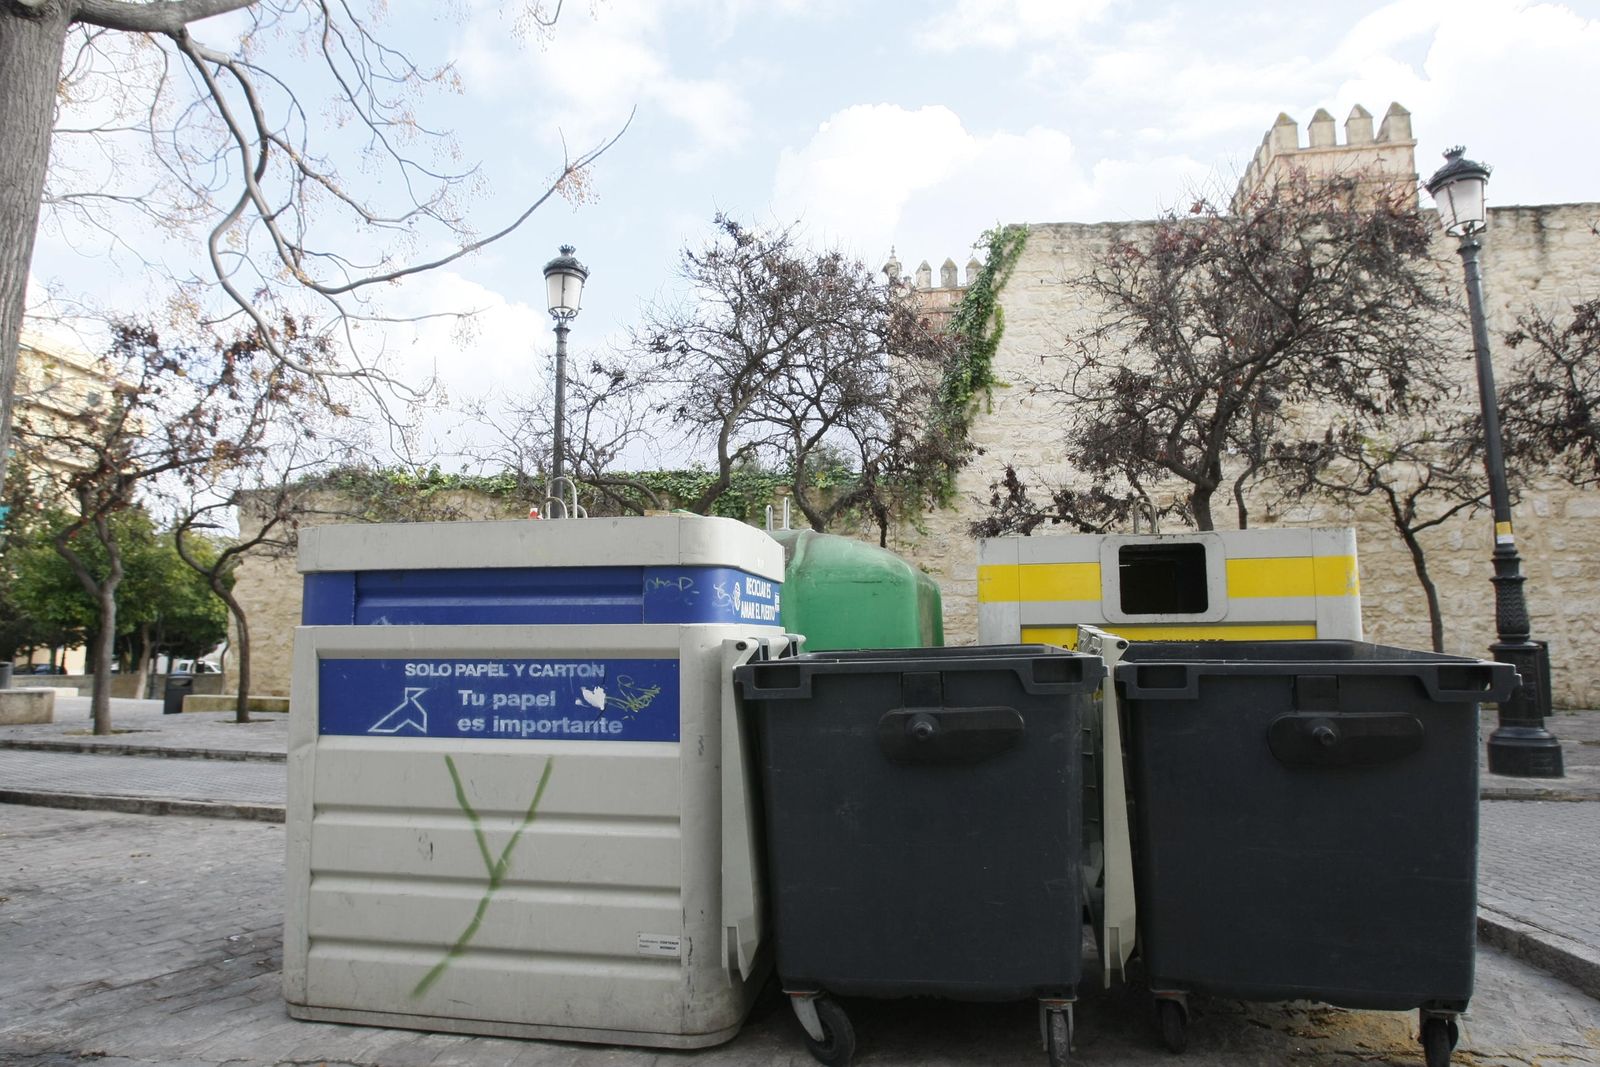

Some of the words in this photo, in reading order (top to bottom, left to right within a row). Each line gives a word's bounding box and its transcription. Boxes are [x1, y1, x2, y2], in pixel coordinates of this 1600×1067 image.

[746, 577, 766, 597] RECICLAR
[767, 583, 771, 599] ES
[741, 601, 755, 618] AMAR
[756, 603, 761, 619] EL
[761, 604, 775, 620] PUERTO
[405, 663, 452, 677] SOLO
[455, 663, 508, 677] PAPEL
[513, 664, 525, 677] Y
[529, 663, 605, 678] CARTON
[458, 690, 485, 706] Tu
[493, 690, 556, 711] papel
[457, 718, 485, 732] es
[493, 716, 623, 736] importante
